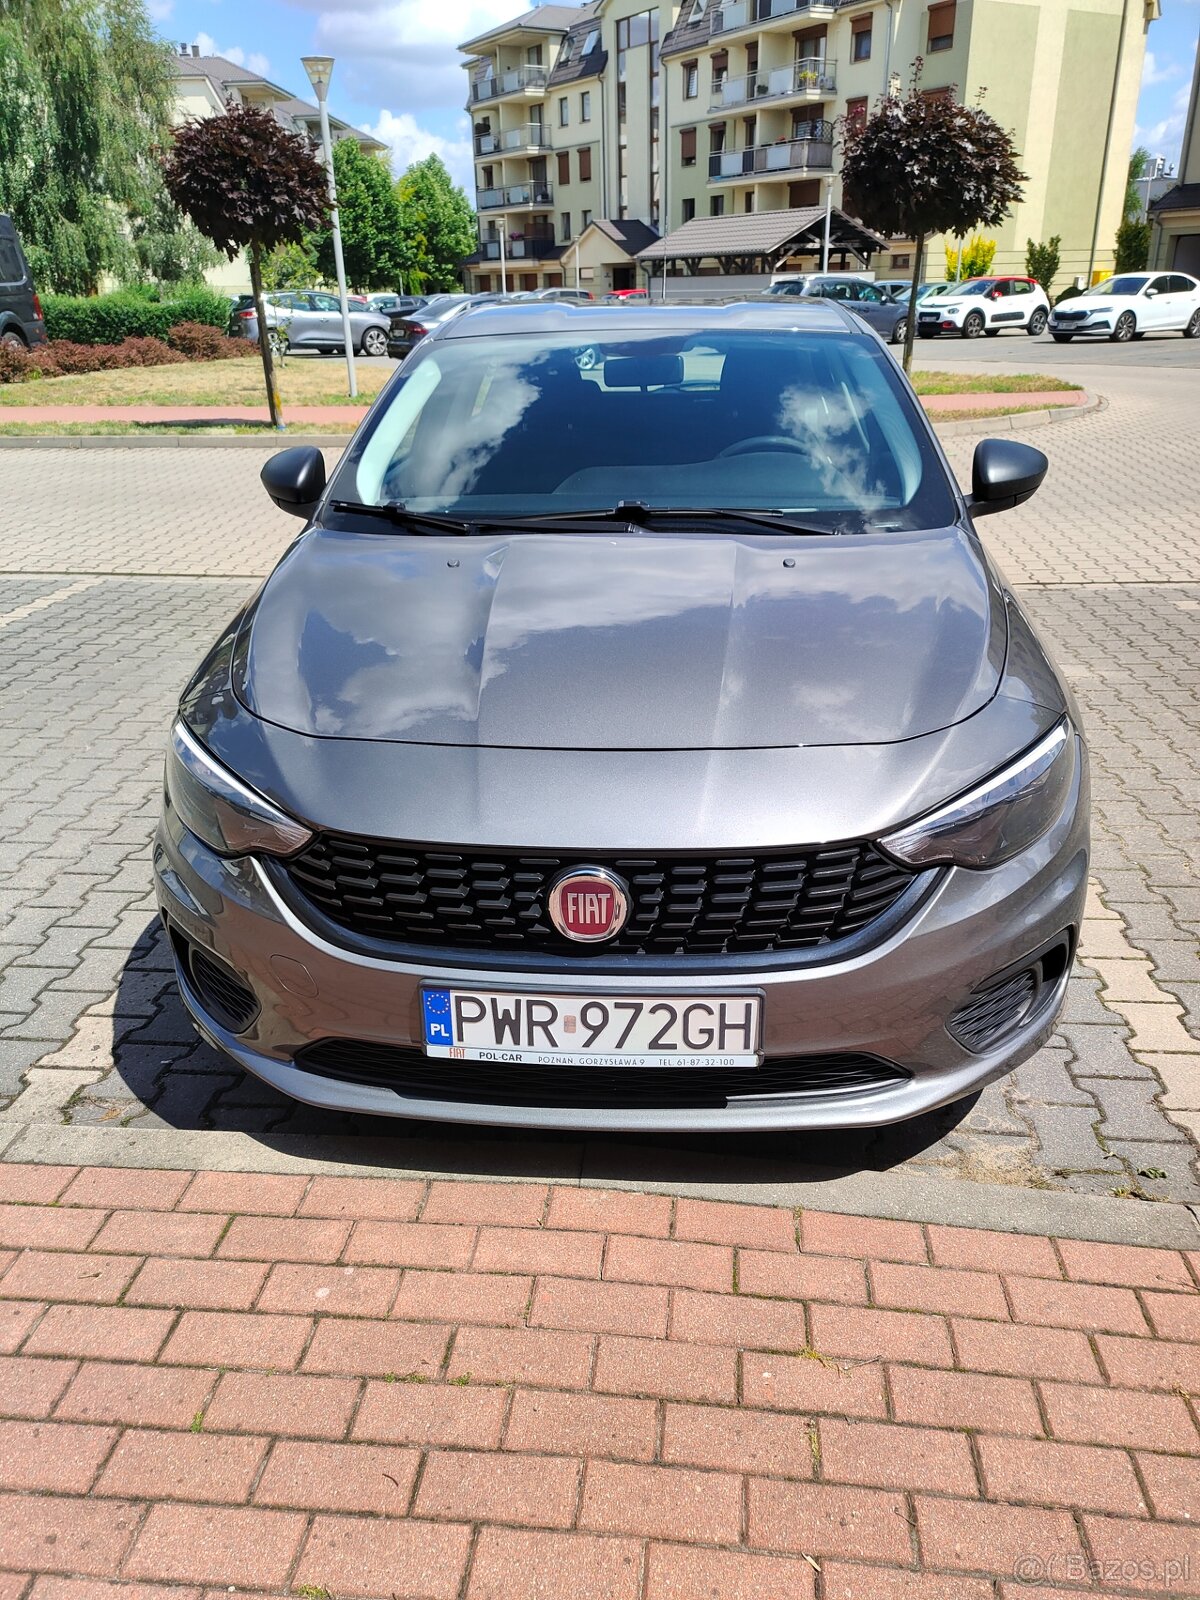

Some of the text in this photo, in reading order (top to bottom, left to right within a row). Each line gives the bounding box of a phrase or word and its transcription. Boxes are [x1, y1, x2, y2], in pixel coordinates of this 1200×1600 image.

[567, 892, 611, 924] FIAT
[430, 1023, 450, 1037] PL
[454, 995, 753, 1051] PWR 972GH
[449, 1047, 466, 1059] FIAT
[479, 1051, 523, 1062] POL-CAR
[639, 1058, 646, 1066] 9
[658, 1058, 674, 1066] TEL.
[676, 1058, 735, 1066] 61-87-32-100
